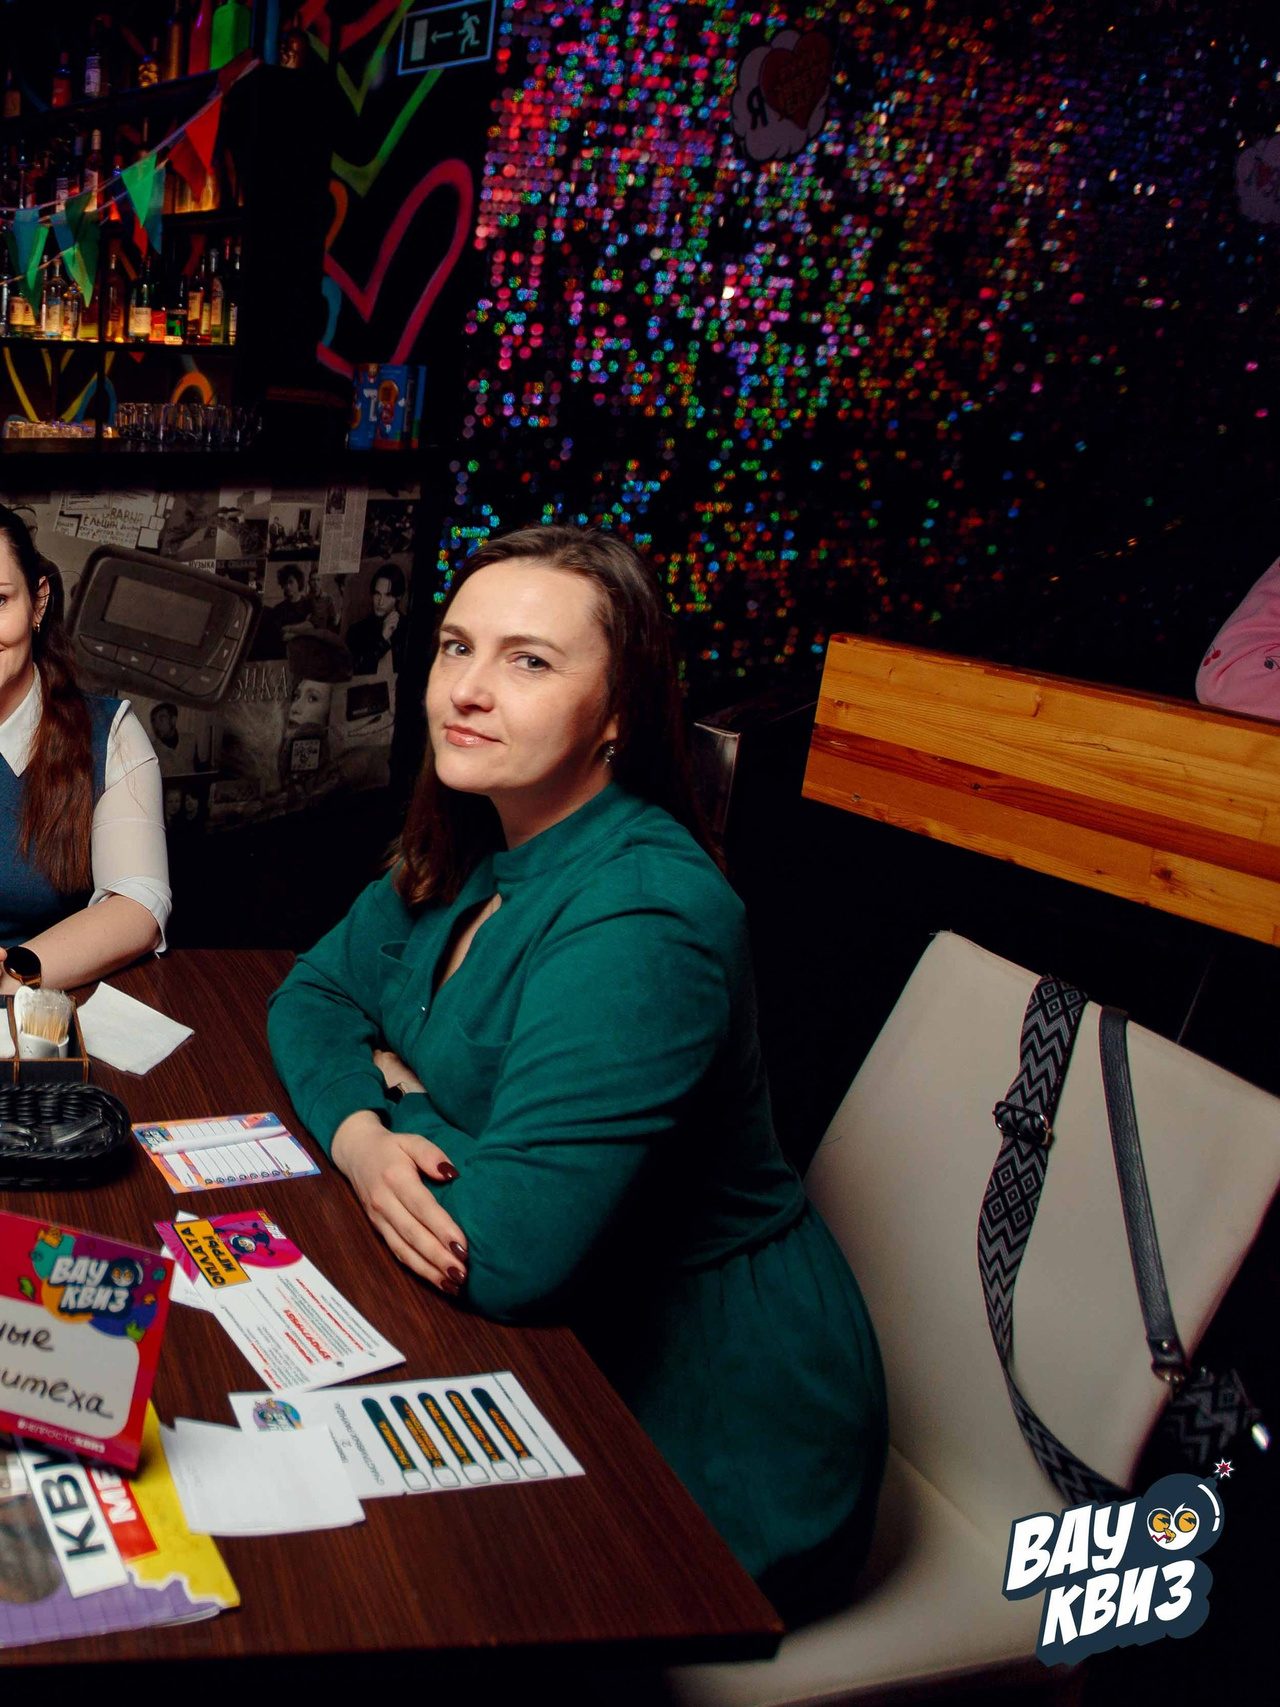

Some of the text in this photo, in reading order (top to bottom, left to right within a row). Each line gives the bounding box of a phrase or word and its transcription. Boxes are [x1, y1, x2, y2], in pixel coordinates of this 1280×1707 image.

[180, 1227, 226, 1286] ОПЛАТА
[202, 1235, 237, 1273] ИГРЫ
[50, 1256, 108, 1290] ВАУ
[59, 1284, 130, 1313] КВИЗ
[377, 1421, 410, 1465] РАЗМИНКА
[465, 1419, 487, 1441] ОДНУ
[481, 1441, 496, 1453] НА
